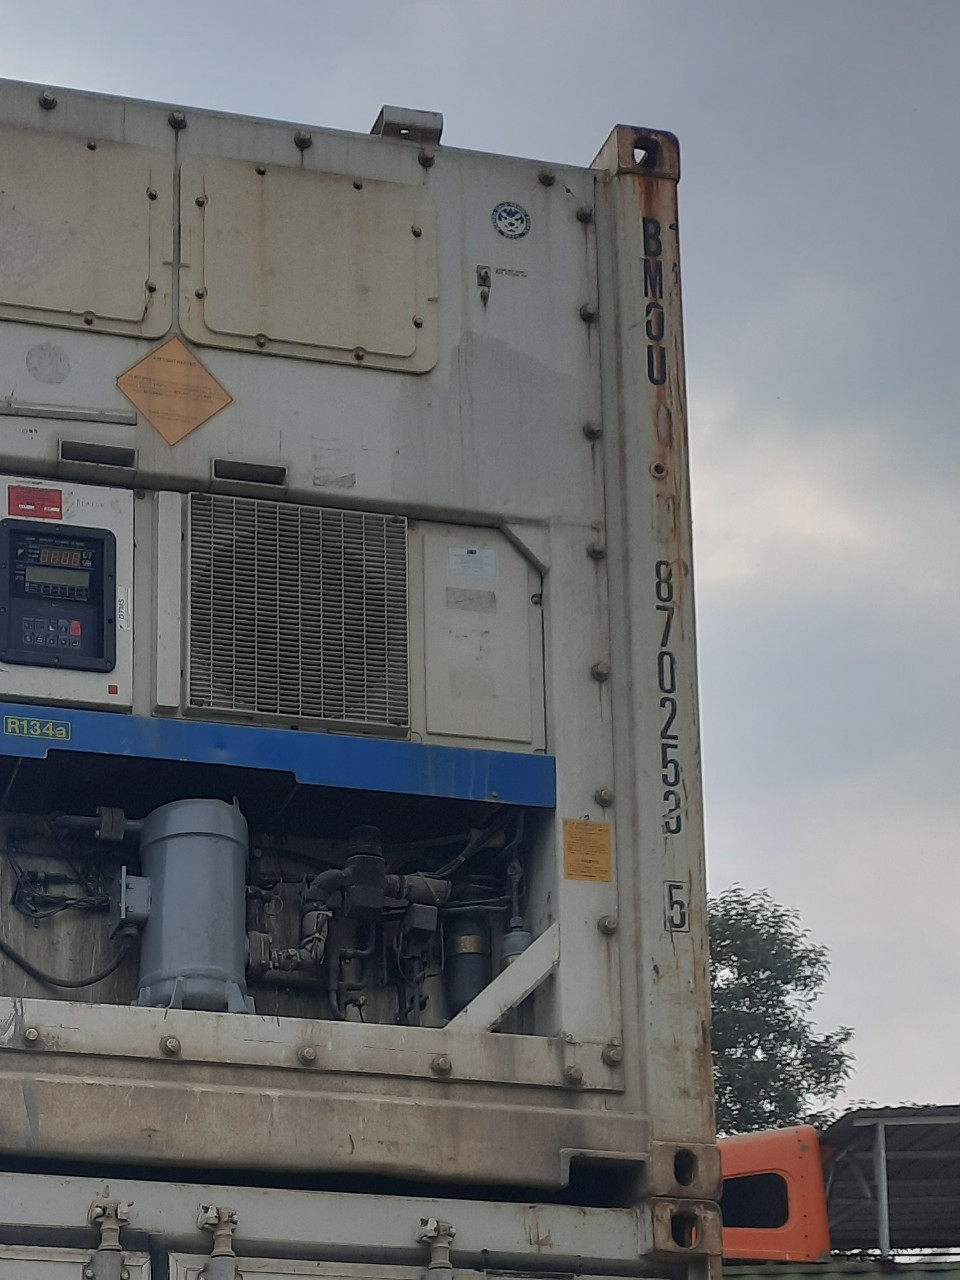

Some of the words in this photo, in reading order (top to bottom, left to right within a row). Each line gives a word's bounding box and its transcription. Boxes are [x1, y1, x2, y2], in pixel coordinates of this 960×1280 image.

[643, 217, 667, 386] BMOU
[7, 718, 67, 738] R134a
[655, 560, 682, 834] 870253
[667, 884, 686, 928] 5
